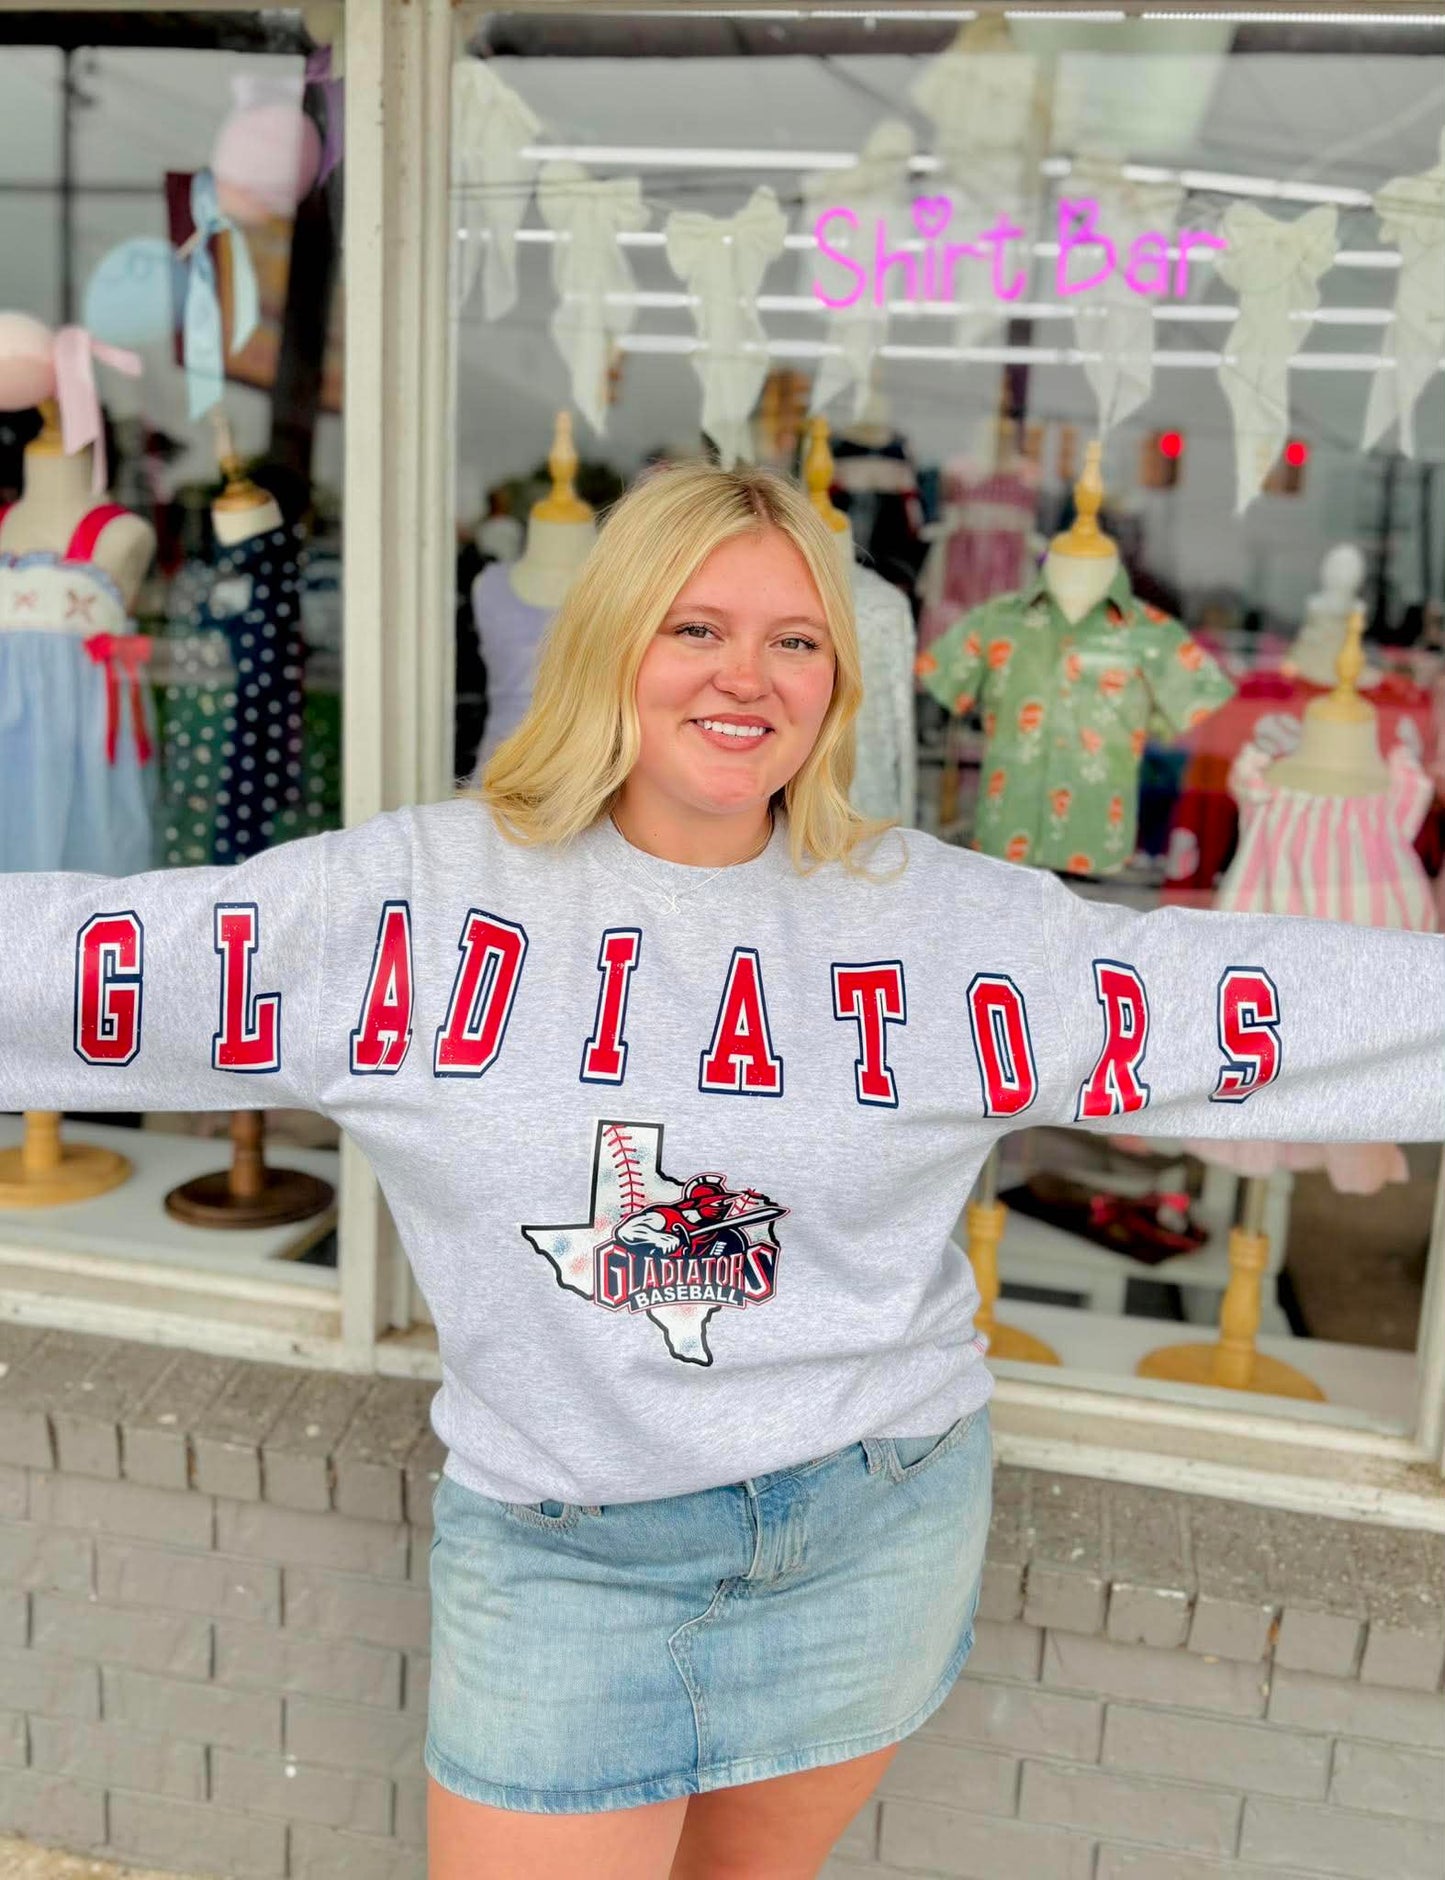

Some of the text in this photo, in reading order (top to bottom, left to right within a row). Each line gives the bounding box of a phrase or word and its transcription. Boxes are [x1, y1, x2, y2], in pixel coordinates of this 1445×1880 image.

[812, 195, 1228, 309] Shirt Bar
[75, 900, 1282, 1121] GLADIATORS
[599, 1244, 777, 1304] GLADIATORS
[635, 1284, 738, 1308] BASEBALL
